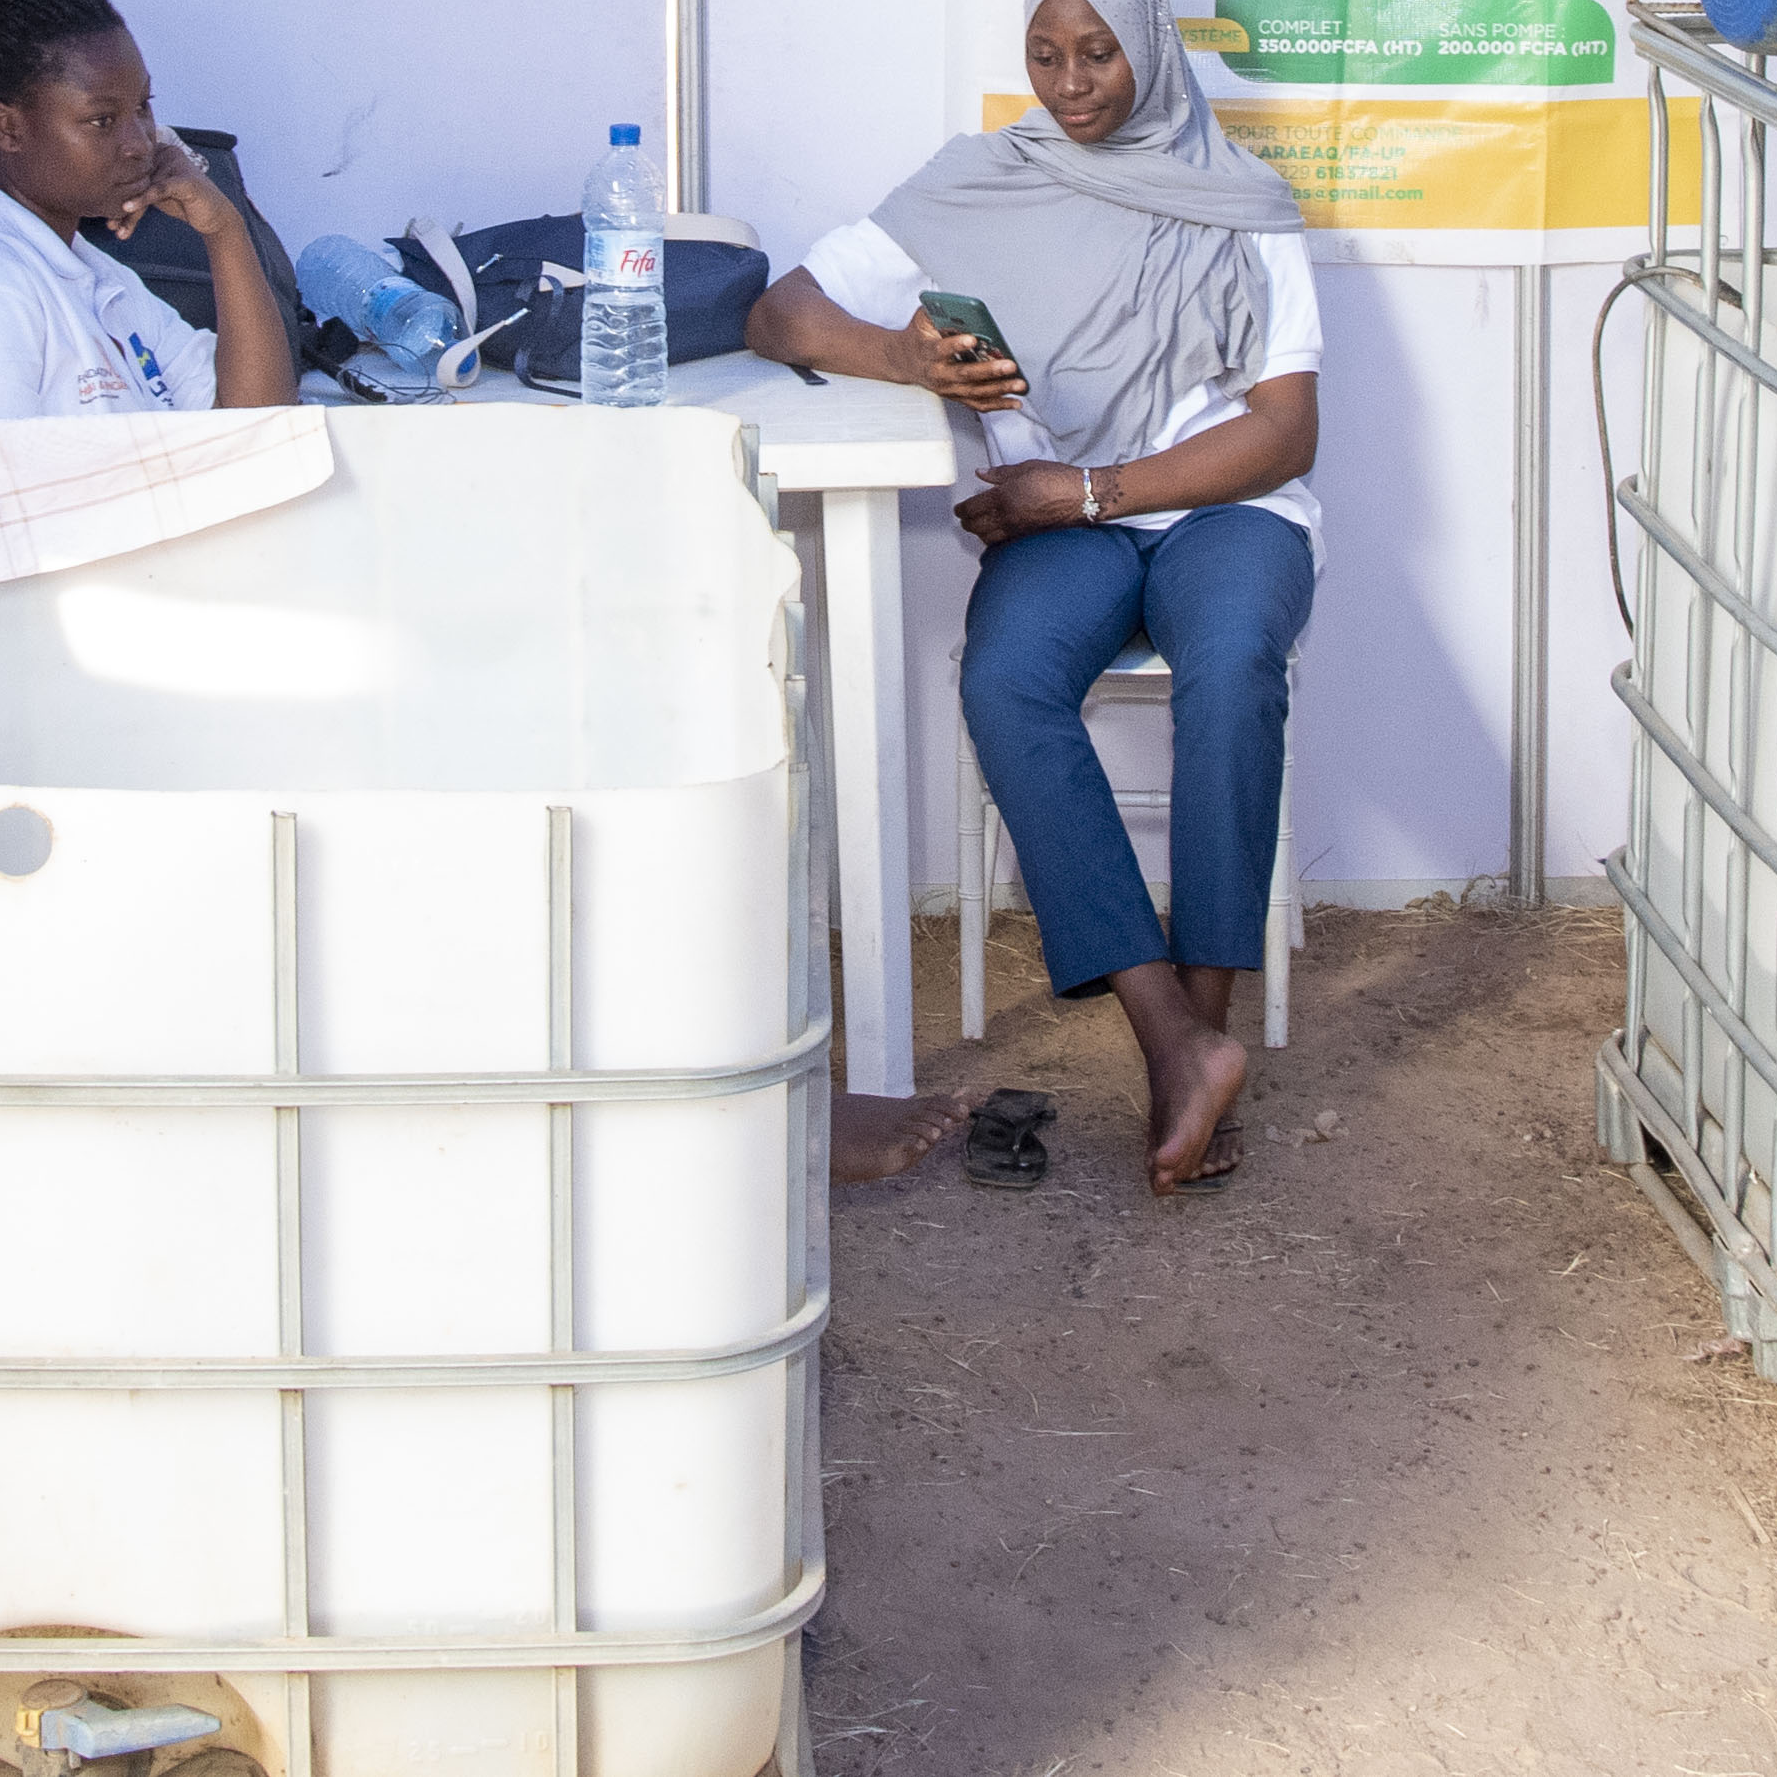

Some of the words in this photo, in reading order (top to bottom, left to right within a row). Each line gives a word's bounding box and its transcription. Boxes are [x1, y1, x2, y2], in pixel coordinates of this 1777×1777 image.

[1180, 27, 1242, 44] YSTÈME
[1258, 19, 1341, 36] COMPLET
[1438, 22, 1489, 38] SANS
[1493, 23, 1557, 39] POMPE
[1258, 39, 1379, 55] 350.000FCFA
[1383, 39, 1423, 57] (HT)
[1438, 40, 1515, 55] 200.000
[1519, 41, 1566, 56] FCFA
[1571, 39, 1608, 57] (HT)
[1225, 125, 1278, 141] POUR
[1283, 126, 1344, 141] TOUTE
[1291, 185, 1424, 203] as@gmail.com
[619, 249, 657, 279] Fifa
